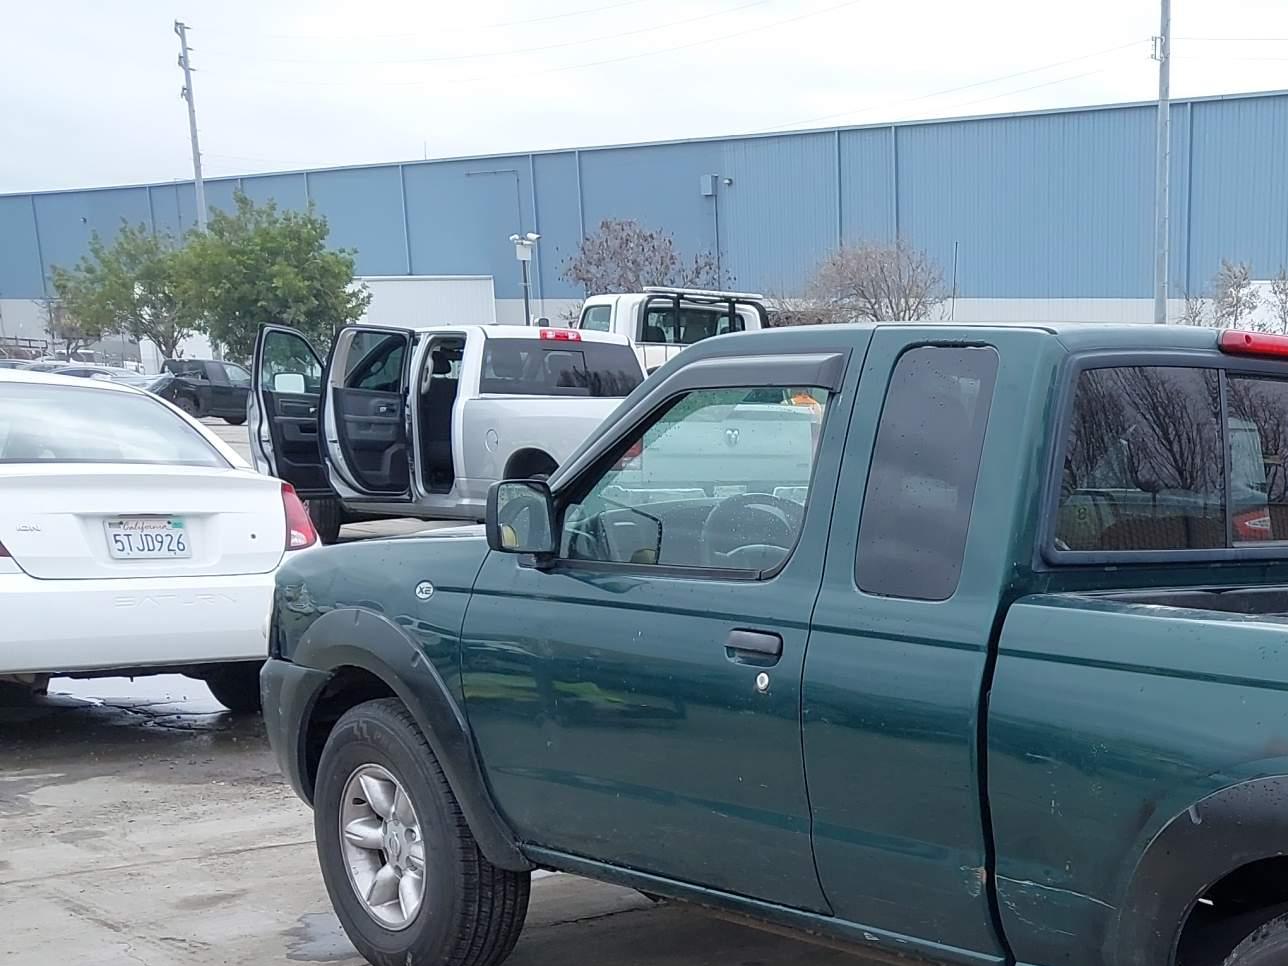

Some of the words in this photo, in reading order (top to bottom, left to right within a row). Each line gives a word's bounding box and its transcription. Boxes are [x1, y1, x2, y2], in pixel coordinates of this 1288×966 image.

[122, 520, 173, 533] California
[112, 533, 186, 552] 5TJD926
[417, 585, 432, 595] XE
